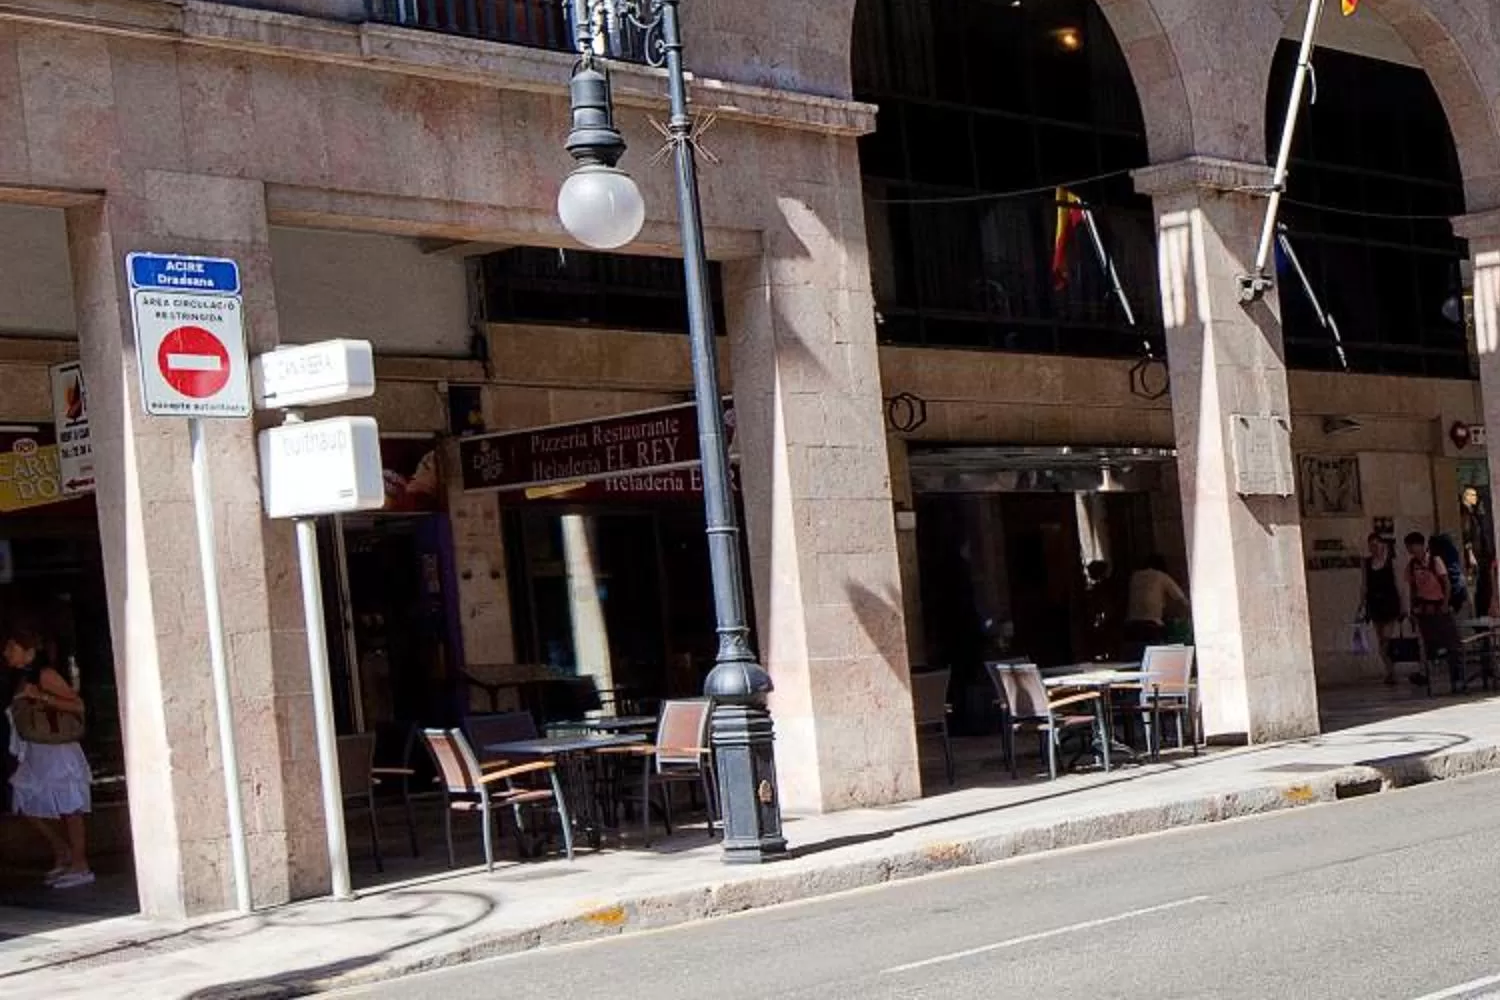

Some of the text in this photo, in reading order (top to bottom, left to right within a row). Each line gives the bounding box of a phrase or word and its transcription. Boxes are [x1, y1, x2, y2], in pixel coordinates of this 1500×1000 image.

[166, 260, 205, 273] ACIRE
[592, 417, 680, 446] Restaurante
[606, 444, 631, 471] EL
[637, 436, 679, 468] REY
